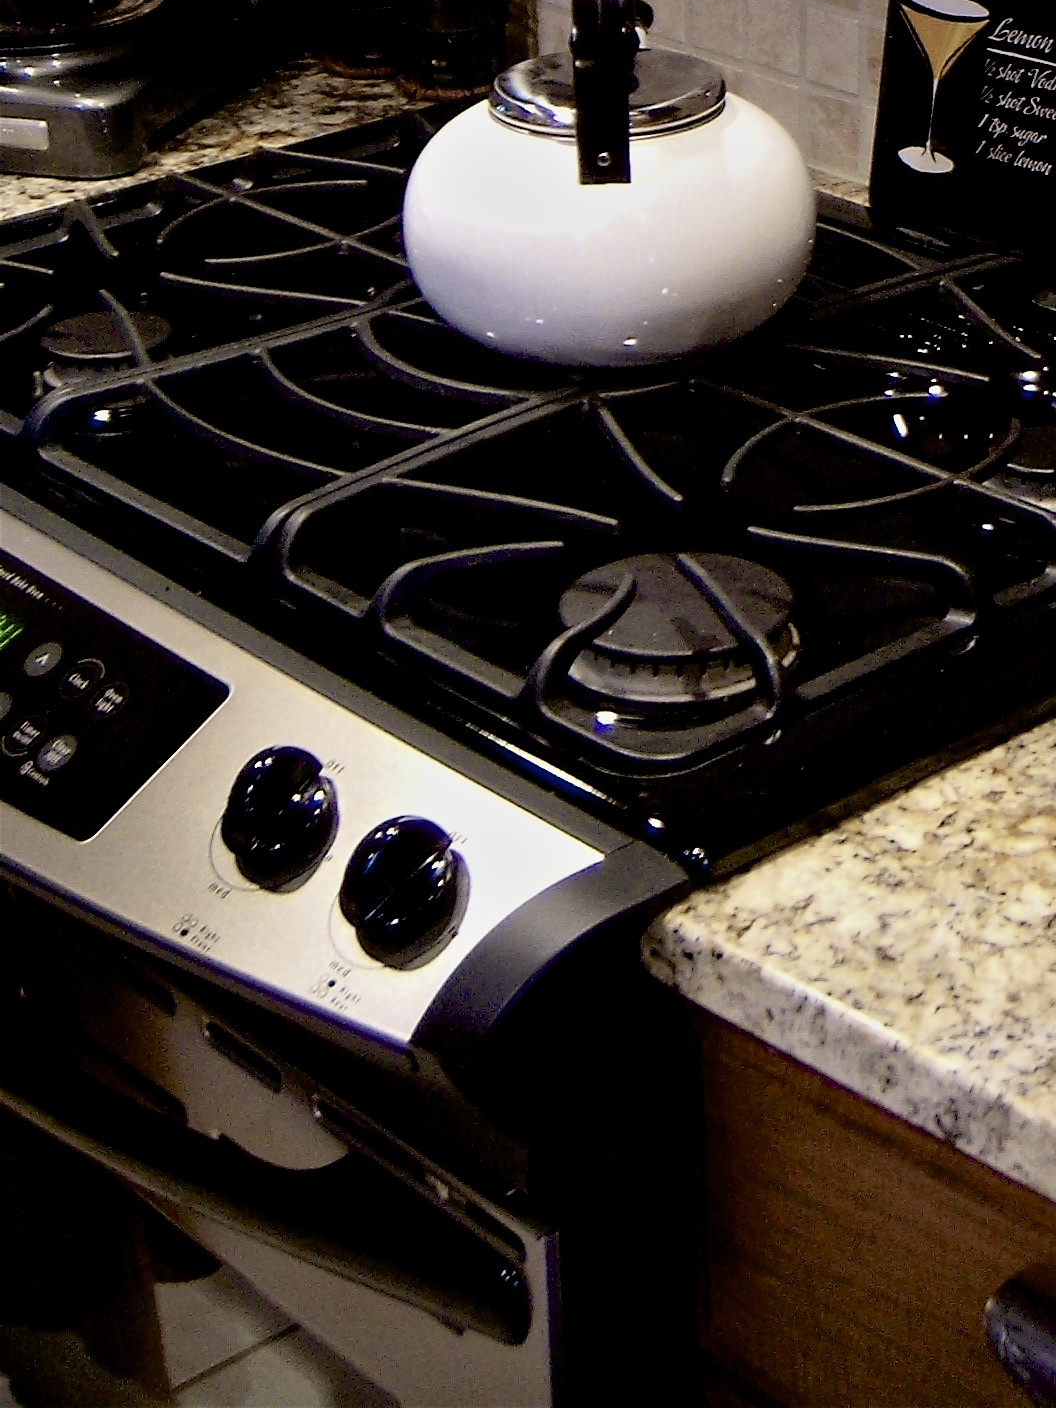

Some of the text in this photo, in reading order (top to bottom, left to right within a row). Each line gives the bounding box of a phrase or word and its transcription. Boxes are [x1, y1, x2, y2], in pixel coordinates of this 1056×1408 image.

[988, 17, 1054, 53] Lemon
[996, 63, 1026, 84] shot
[995, 90, 1027, 112] shot
[1010, 125, 1048, 147] sugar
[987, 143, 1013, 163] slice
[1013, 149, 1053, 176] lemon
